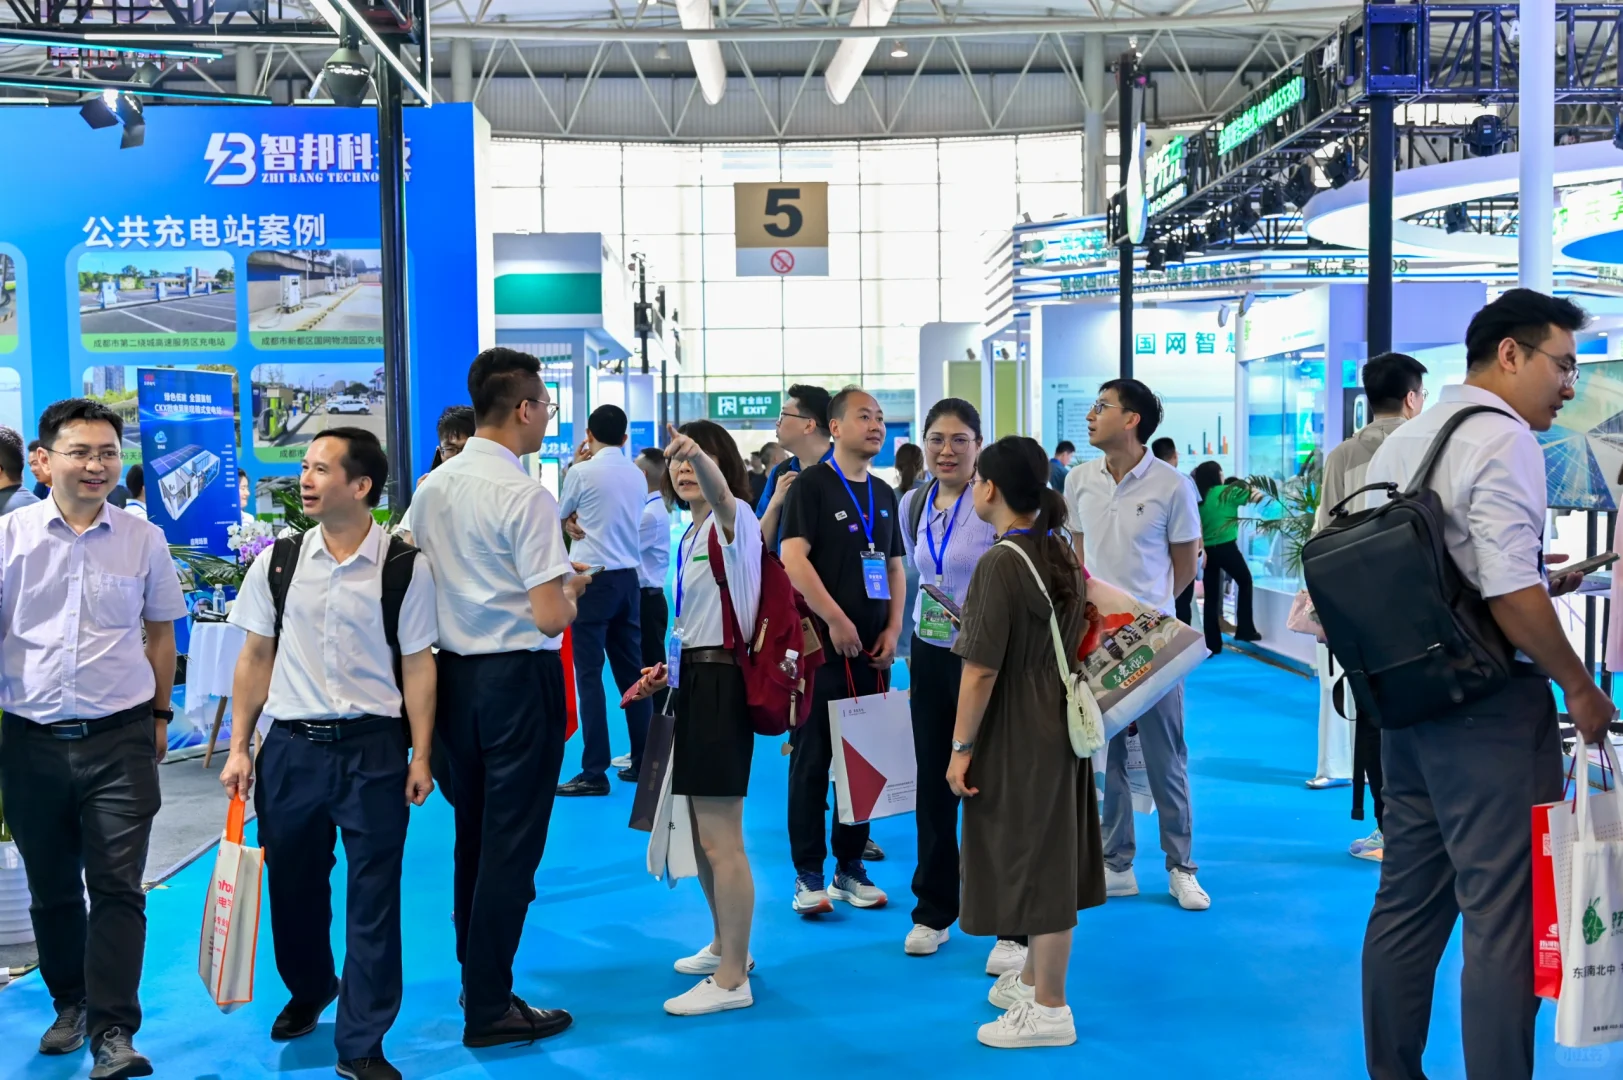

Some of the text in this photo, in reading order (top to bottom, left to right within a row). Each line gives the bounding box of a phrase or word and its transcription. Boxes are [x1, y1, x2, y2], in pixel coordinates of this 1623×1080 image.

[261, 172, 411, 183] ZHI BANG TECHNOY
[763, 188, 803, 238] 5
[82, 213, 326, 248] 公共充电站案例
[93, 337, 226, 348] 成都市第二绕城高速服务区充电站
[738, 396, 772, 405] 安全出口
[743, 406, 767, 415] EXIT
